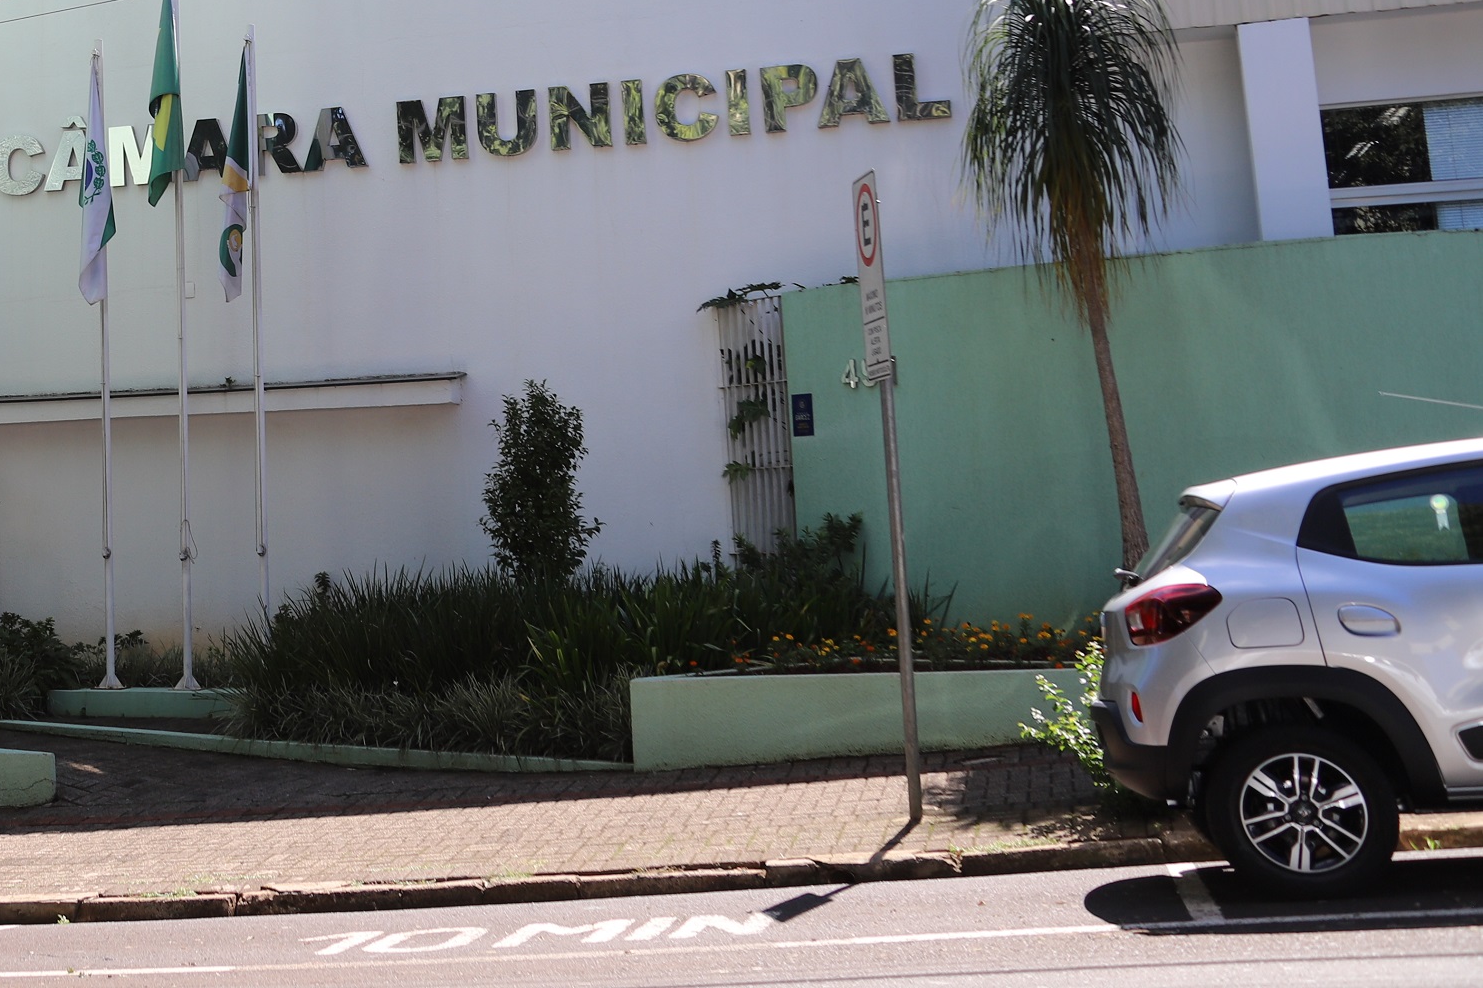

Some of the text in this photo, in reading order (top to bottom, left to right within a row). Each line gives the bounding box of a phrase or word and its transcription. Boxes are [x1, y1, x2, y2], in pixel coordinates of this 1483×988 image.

[396, 52, 953, 164] MUNICIPAL
[299, 911, 775, 956] 10 MIN
